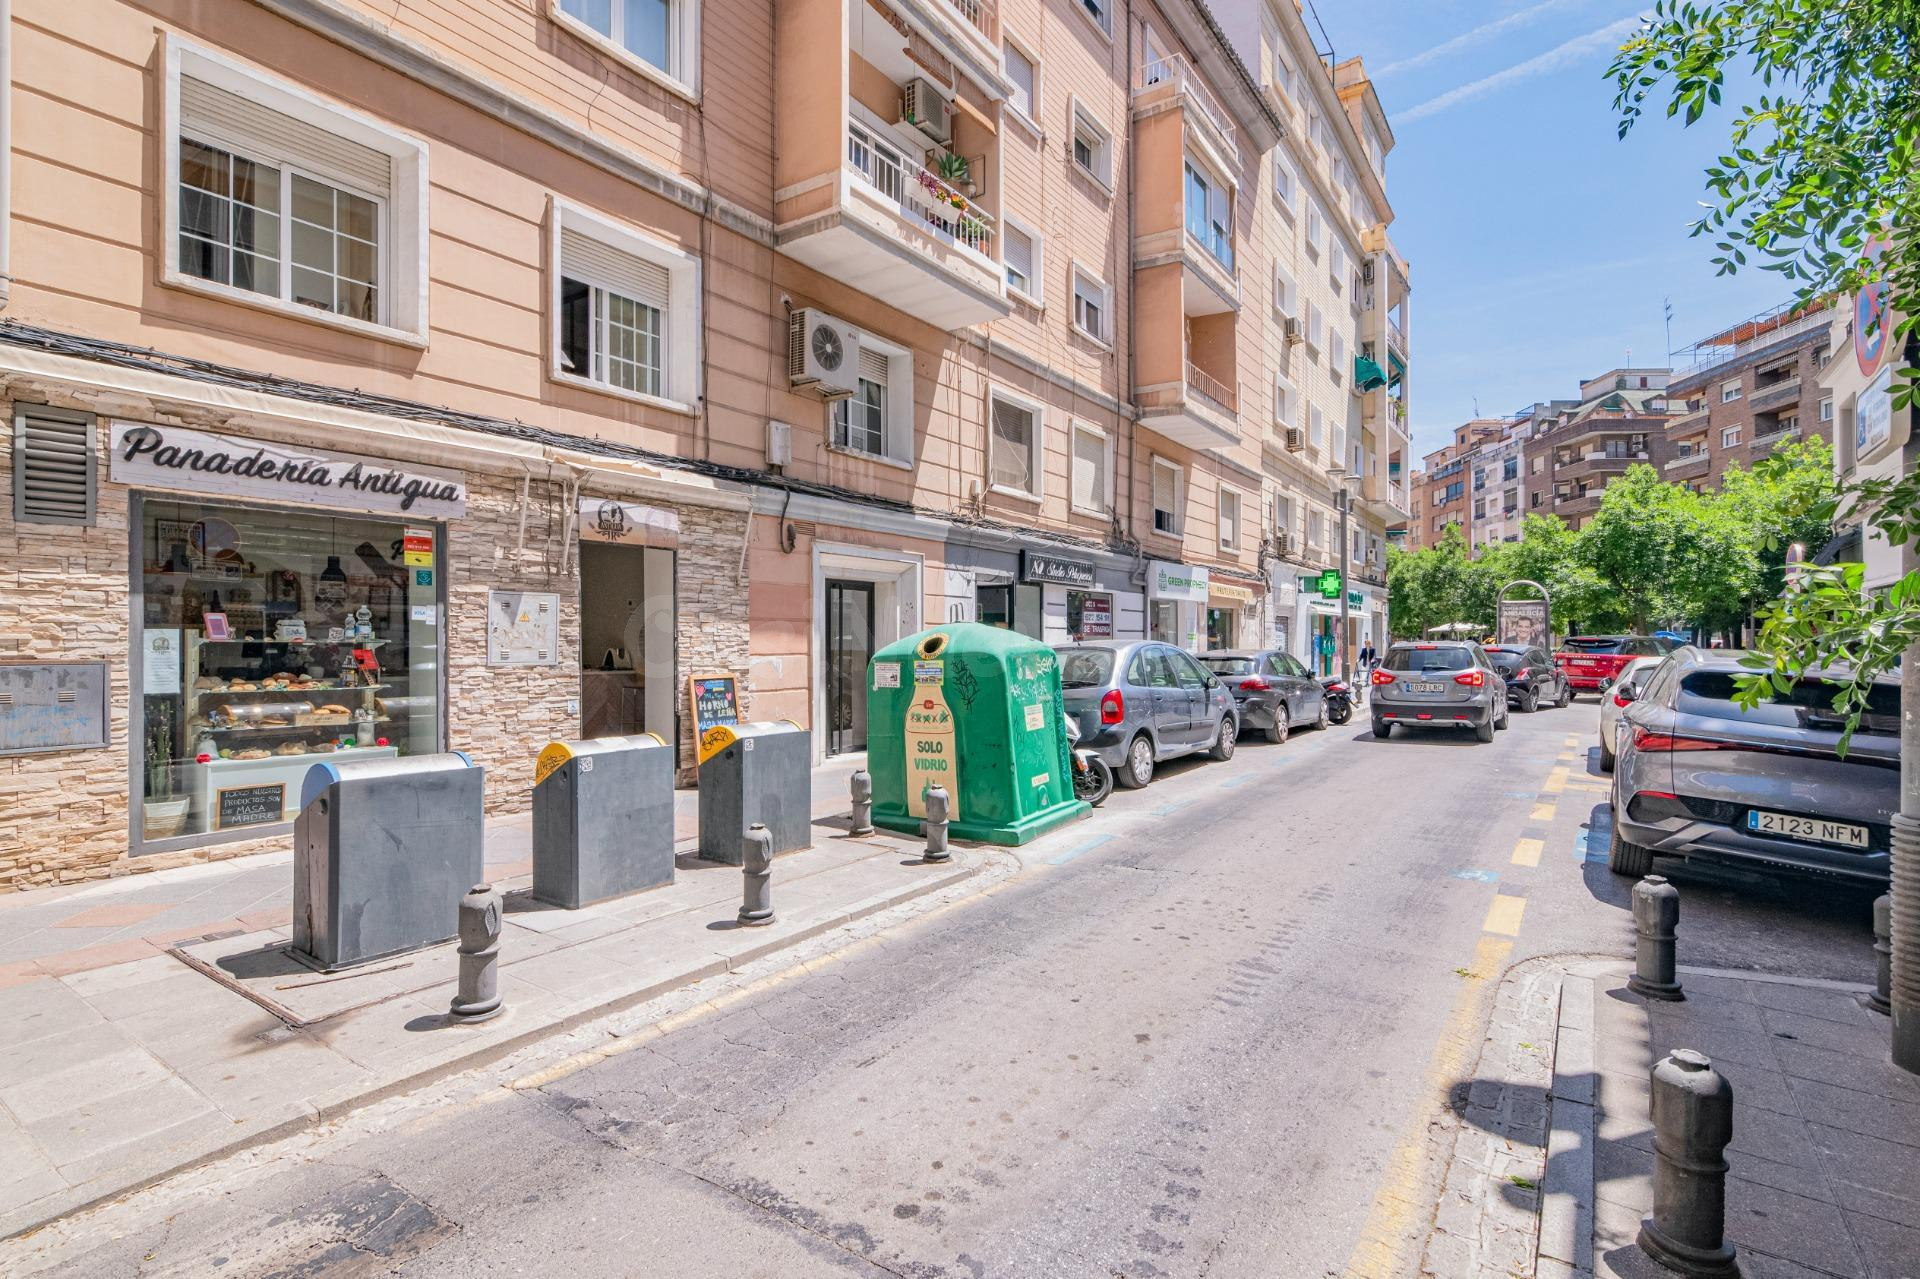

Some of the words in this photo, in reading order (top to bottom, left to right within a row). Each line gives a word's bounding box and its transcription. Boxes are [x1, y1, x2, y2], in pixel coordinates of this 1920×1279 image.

[337, 462, 460, 510] Antigua
[1168, 576, 1184, 586] GREEN
[698, 700, 729, 711] HORNO
[917, 740, 943, 754] SOLO
[914, 758, 948, 772] VIDRIO
[236, 804, 266, 816] MASA
[231, 812, 273, 824] MADRE
[1762, 815, 1813, 835] 2123
[1822, 823, 1862, 844] NFM
